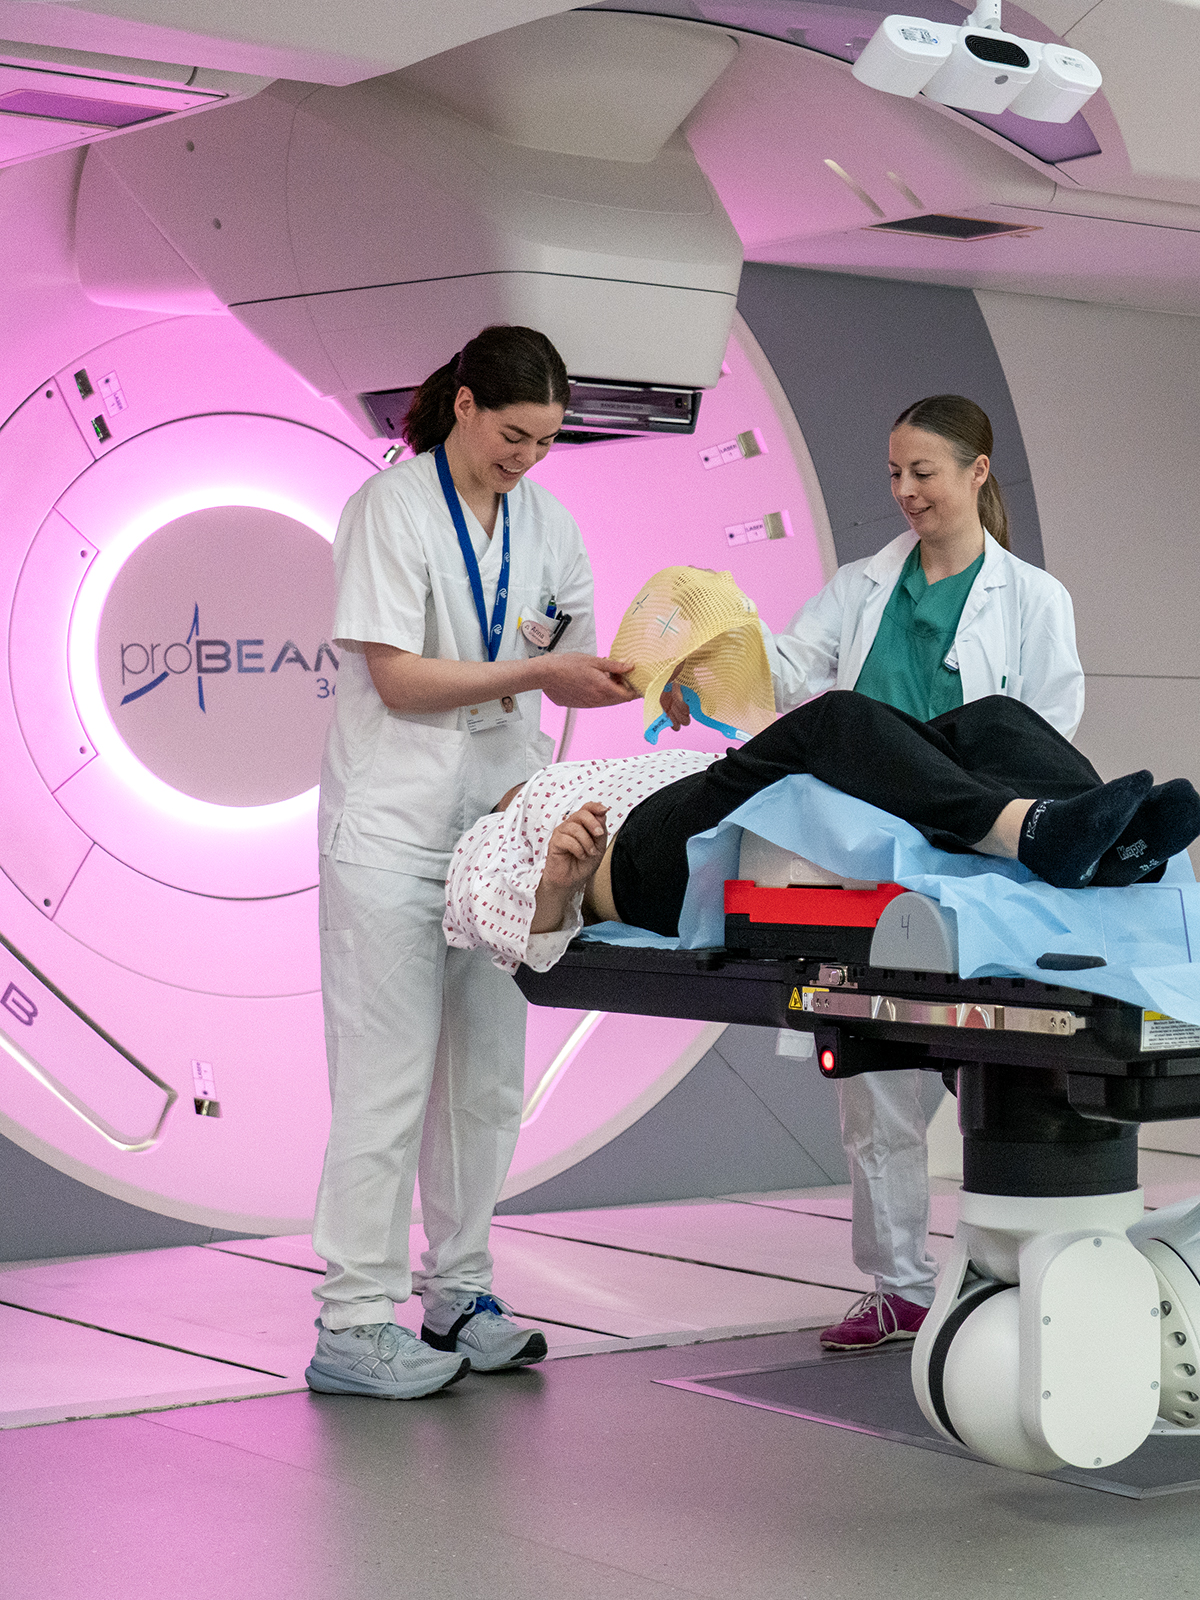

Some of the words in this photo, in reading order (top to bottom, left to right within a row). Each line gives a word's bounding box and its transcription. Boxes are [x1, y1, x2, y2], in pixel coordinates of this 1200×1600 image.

[1116, 839, 1148, 861] Kappa
[901, 914, 911, 940] 4
[0, 981, 38, 1026] B
